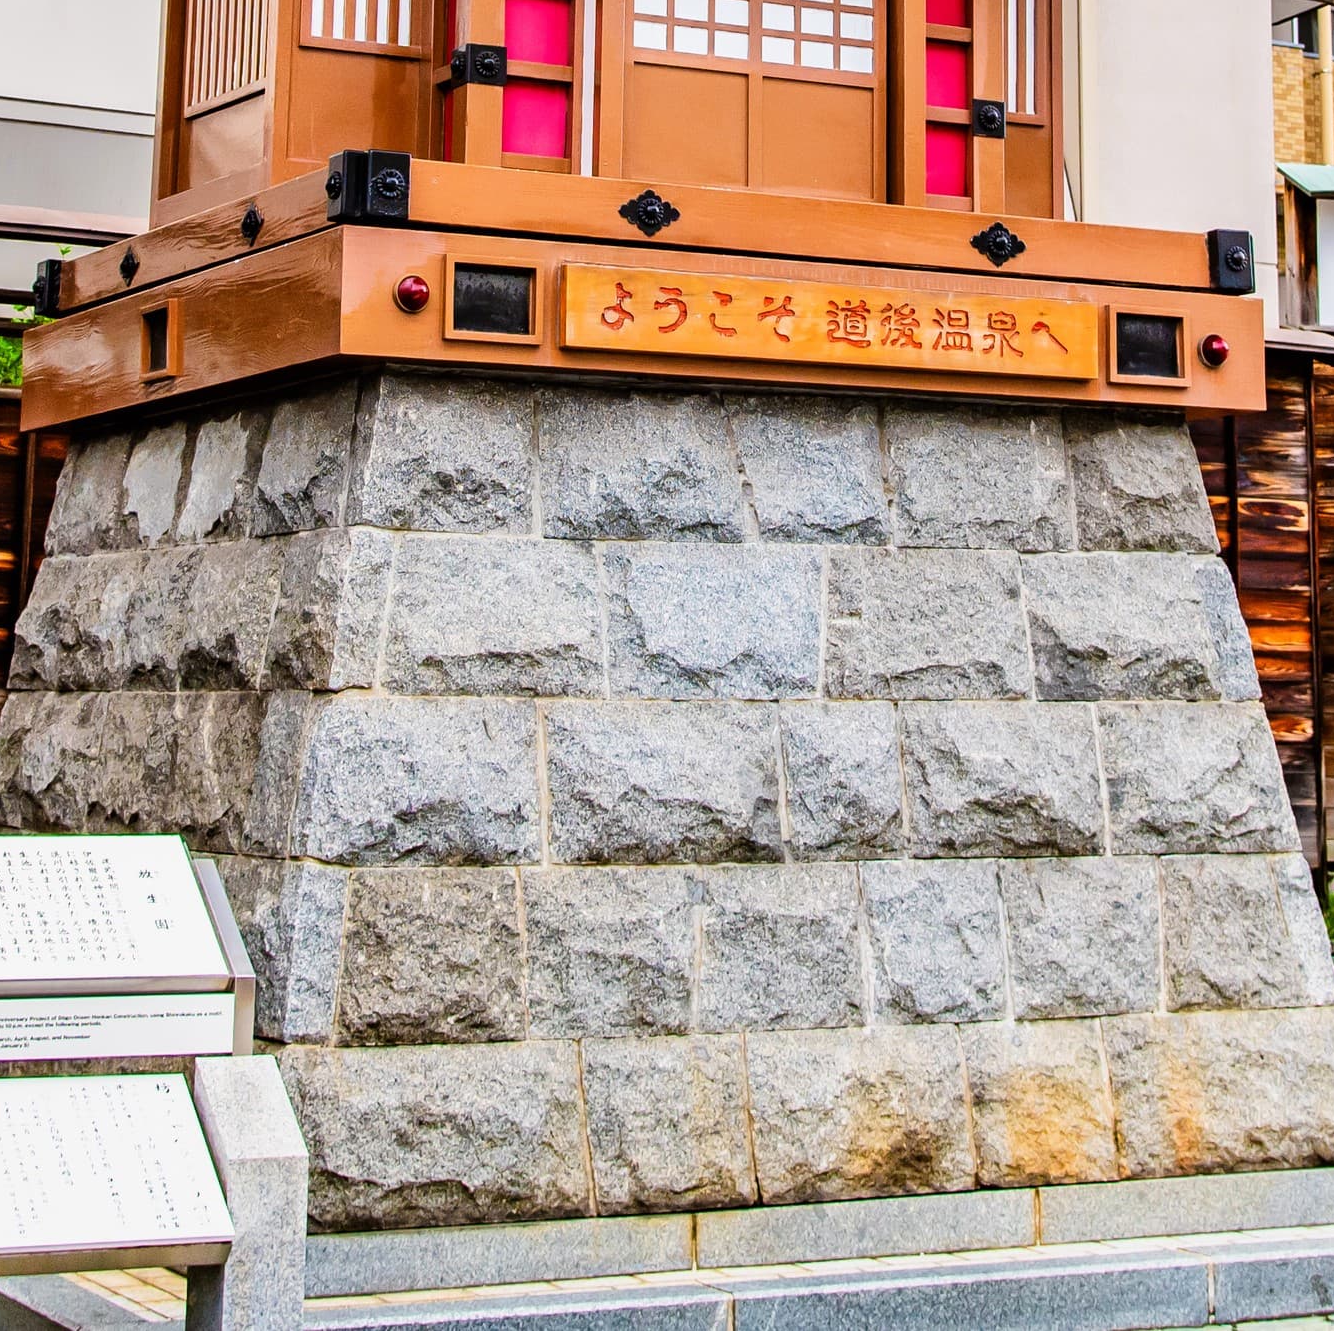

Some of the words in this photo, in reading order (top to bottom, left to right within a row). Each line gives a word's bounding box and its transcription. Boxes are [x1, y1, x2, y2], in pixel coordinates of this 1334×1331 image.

[600, 282, 795, 343] ようこそ
[826, 299, 1068, 358] 道後温泉へ
